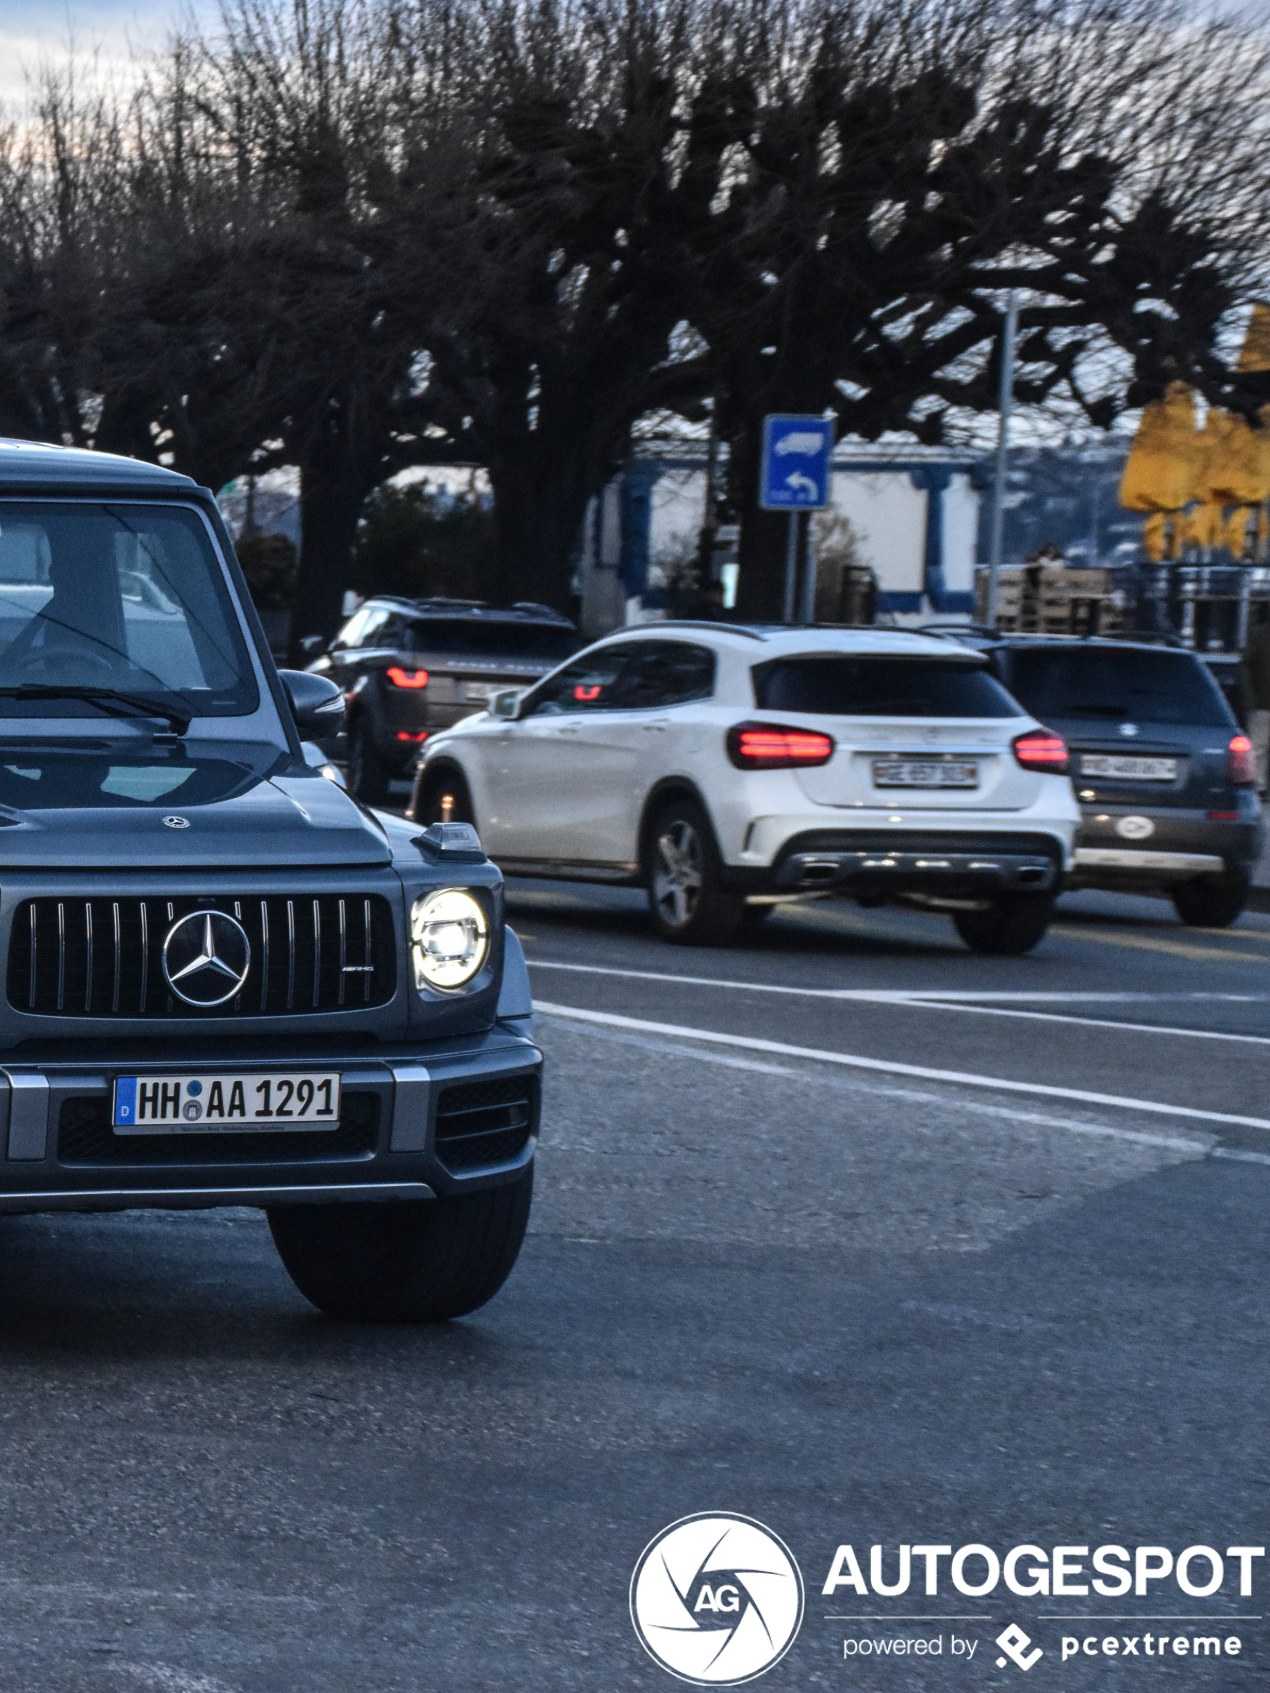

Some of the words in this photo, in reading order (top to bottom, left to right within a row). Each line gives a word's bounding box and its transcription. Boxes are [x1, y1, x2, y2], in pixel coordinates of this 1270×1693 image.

[121, 1105, 129, 1117] D
[139, 1082, 181, 1119] HH
[206, 1080, 246, 1118] AA
[255, 1078, 334, 1117] 1291
